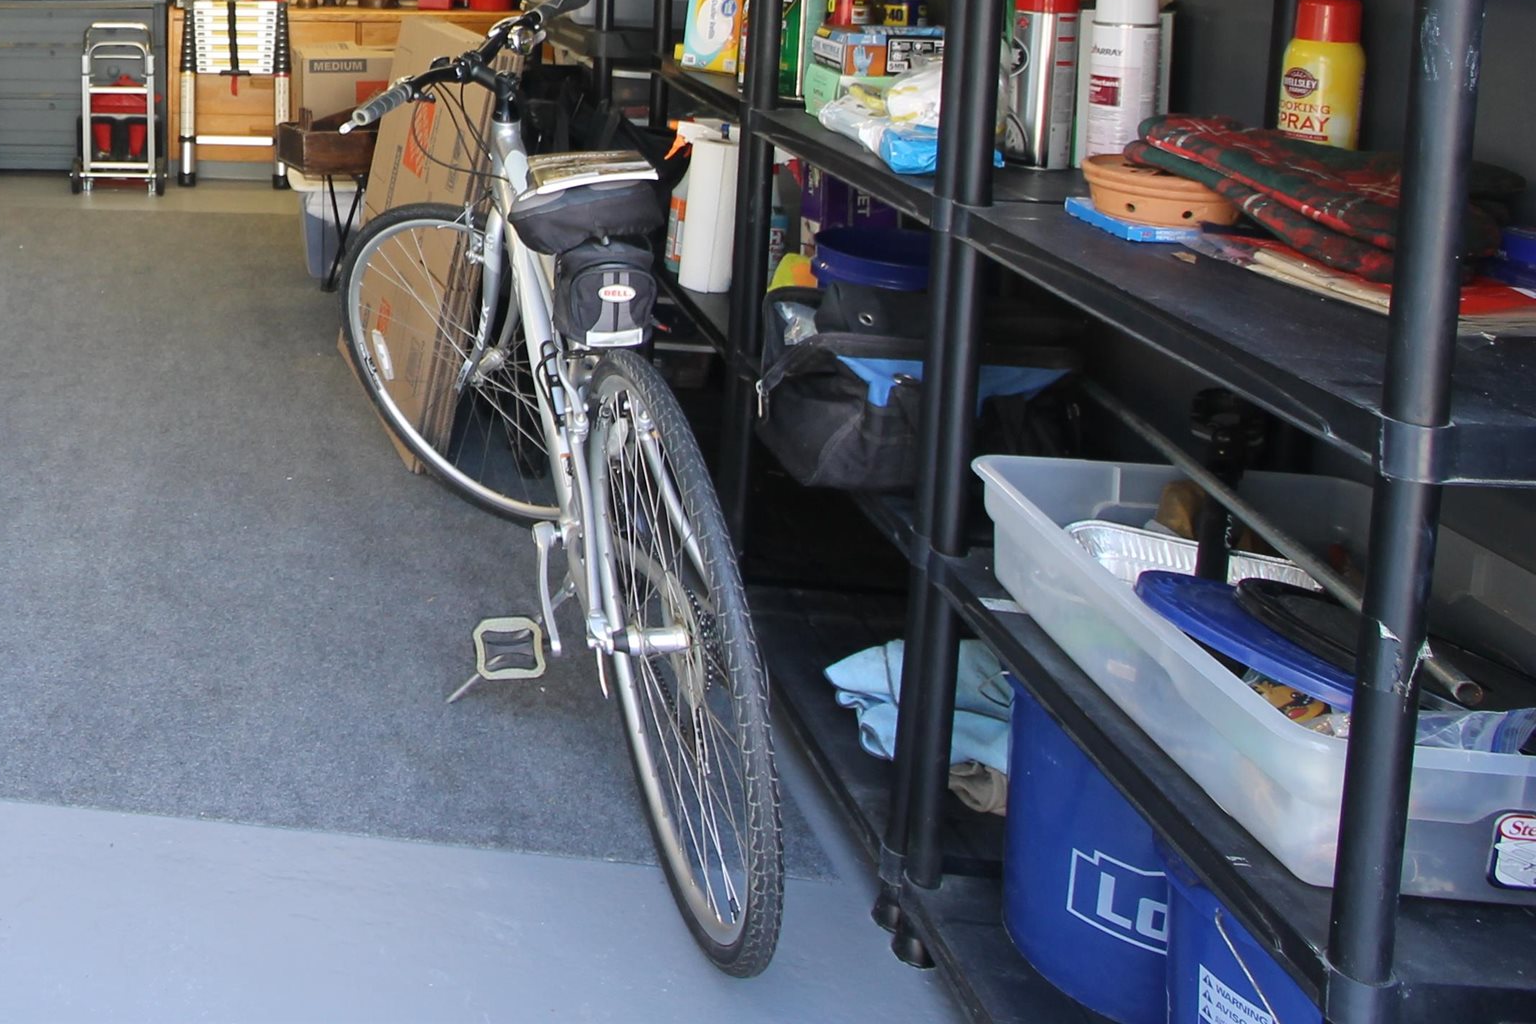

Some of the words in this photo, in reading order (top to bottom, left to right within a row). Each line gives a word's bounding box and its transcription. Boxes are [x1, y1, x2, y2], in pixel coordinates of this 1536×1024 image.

[313, 61, 363, 72] MEDIUM
[1280, 111, 1330, 133] PRAY
[1508, 820, 1536, 837] Ste
[1096, 871, 1169, 943] LO
[1215, 984, 1270, 1024] WARNING
